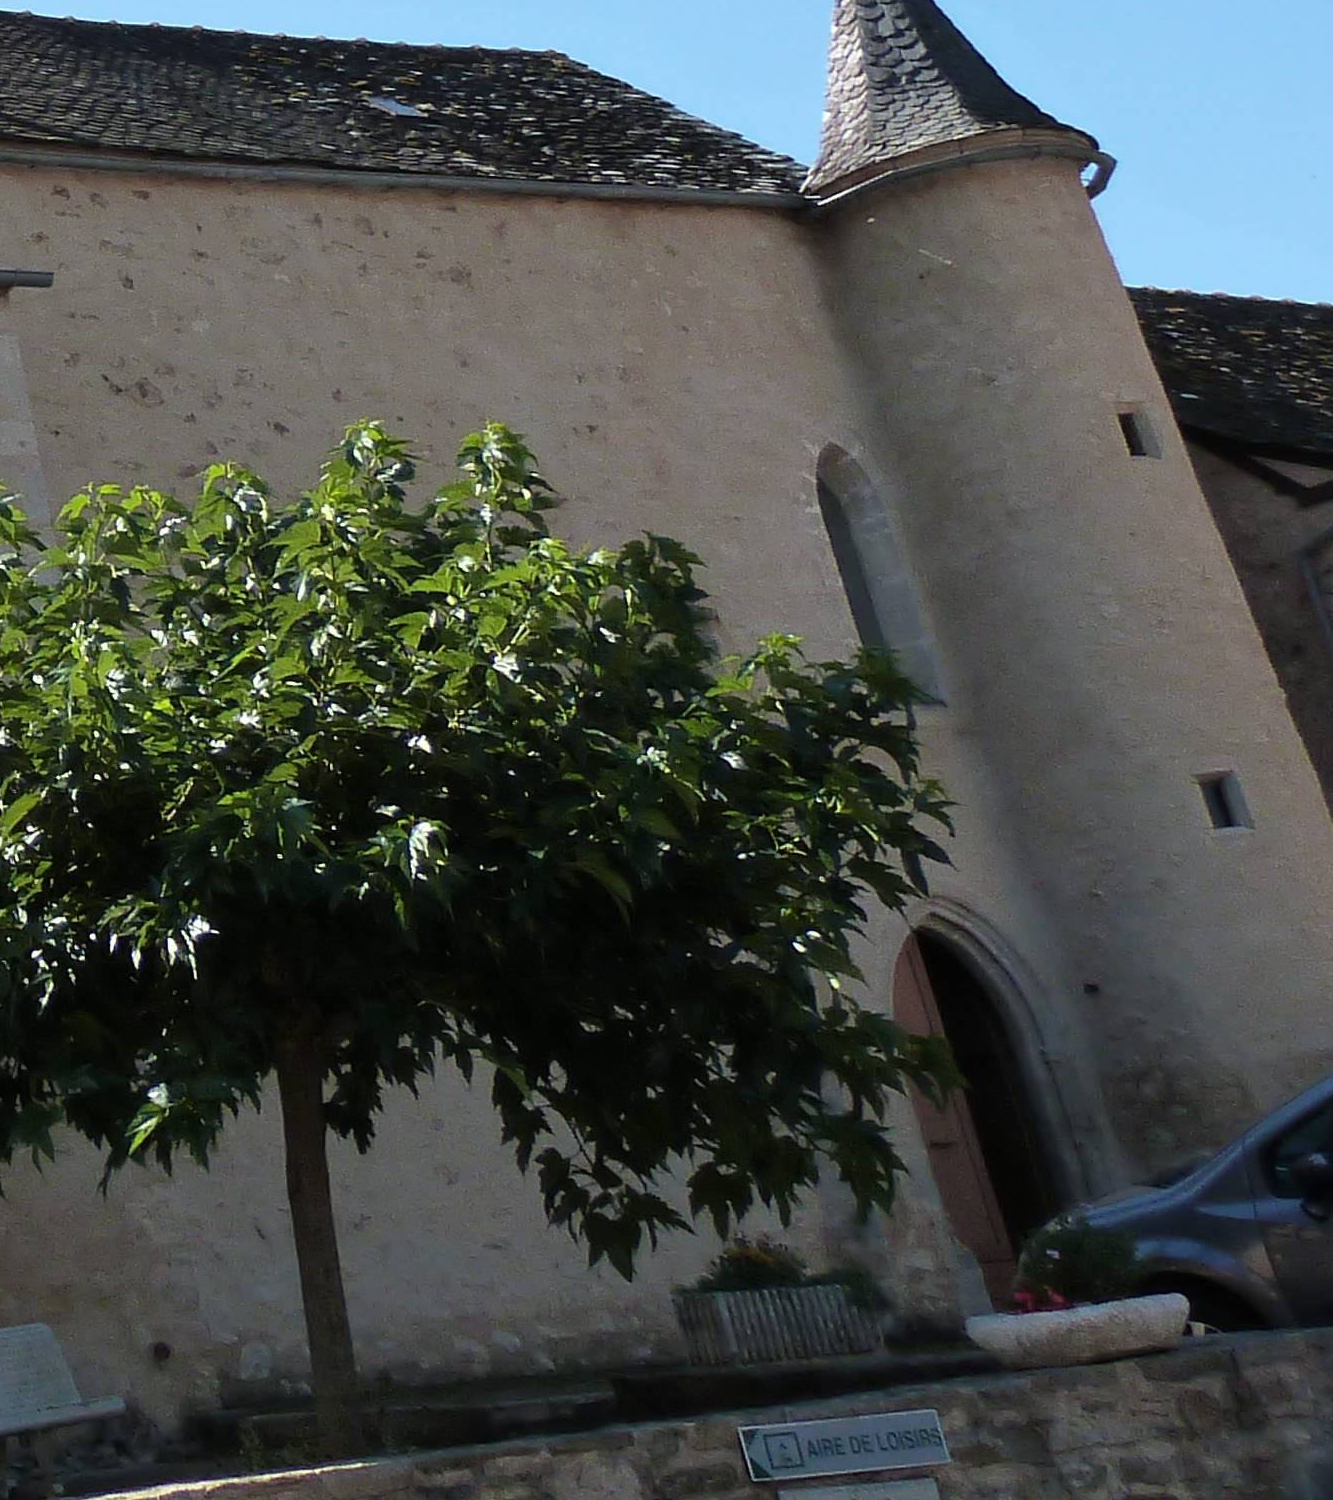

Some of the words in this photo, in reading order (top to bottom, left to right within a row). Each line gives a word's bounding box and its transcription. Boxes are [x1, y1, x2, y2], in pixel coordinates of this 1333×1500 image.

[807, 1437, 845, 1457] AIRE
[849, 1433, 874, 1453] DE
[876, 1427, 942, 1451] LOISIRS
